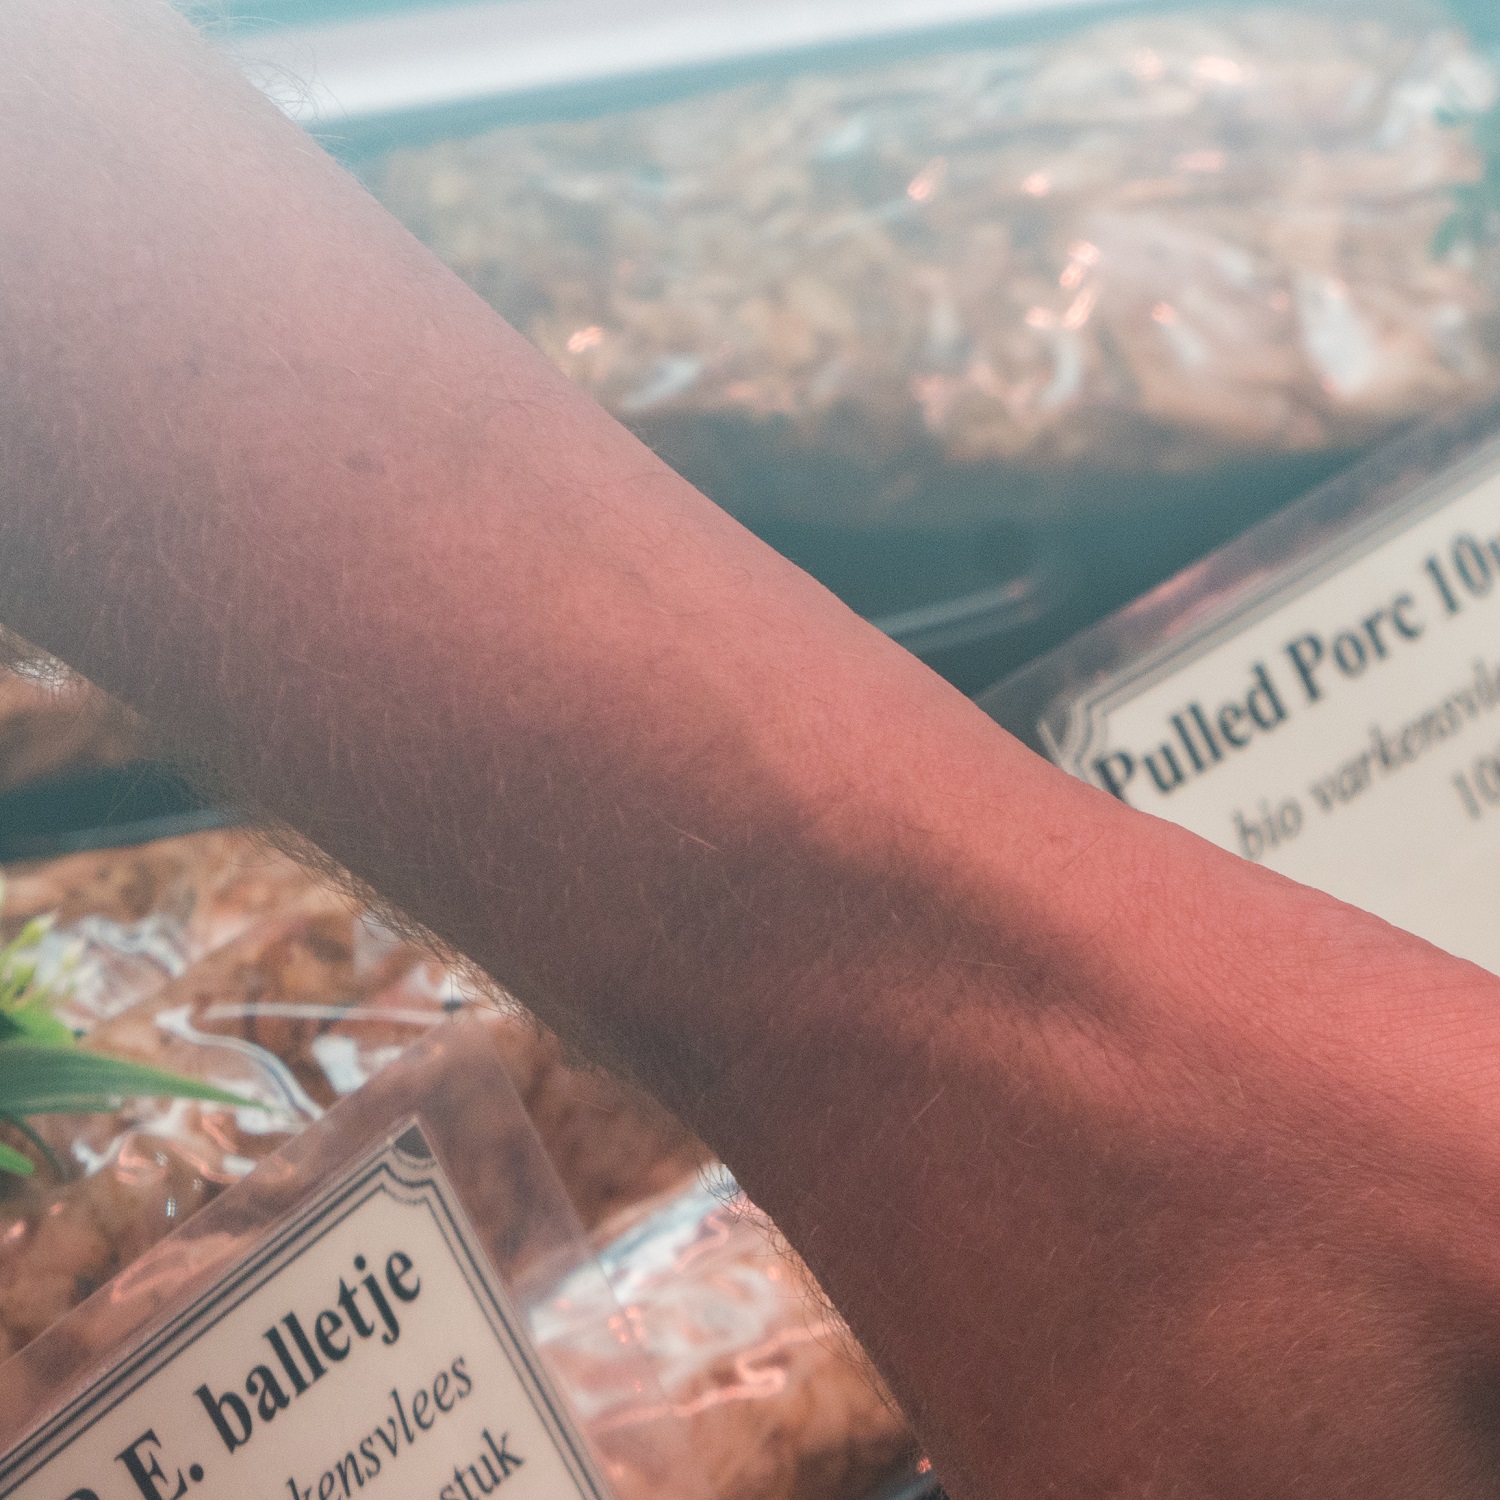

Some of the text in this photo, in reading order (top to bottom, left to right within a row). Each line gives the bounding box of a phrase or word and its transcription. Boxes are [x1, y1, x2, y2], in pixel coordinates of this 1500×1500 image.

[1092, 661, 1288, 804] Pulled
[1284, 593, 1425, 704] Porc
[1231, 799, 1302, 861] bio
[193, 1249, 422, 1455] balletje
